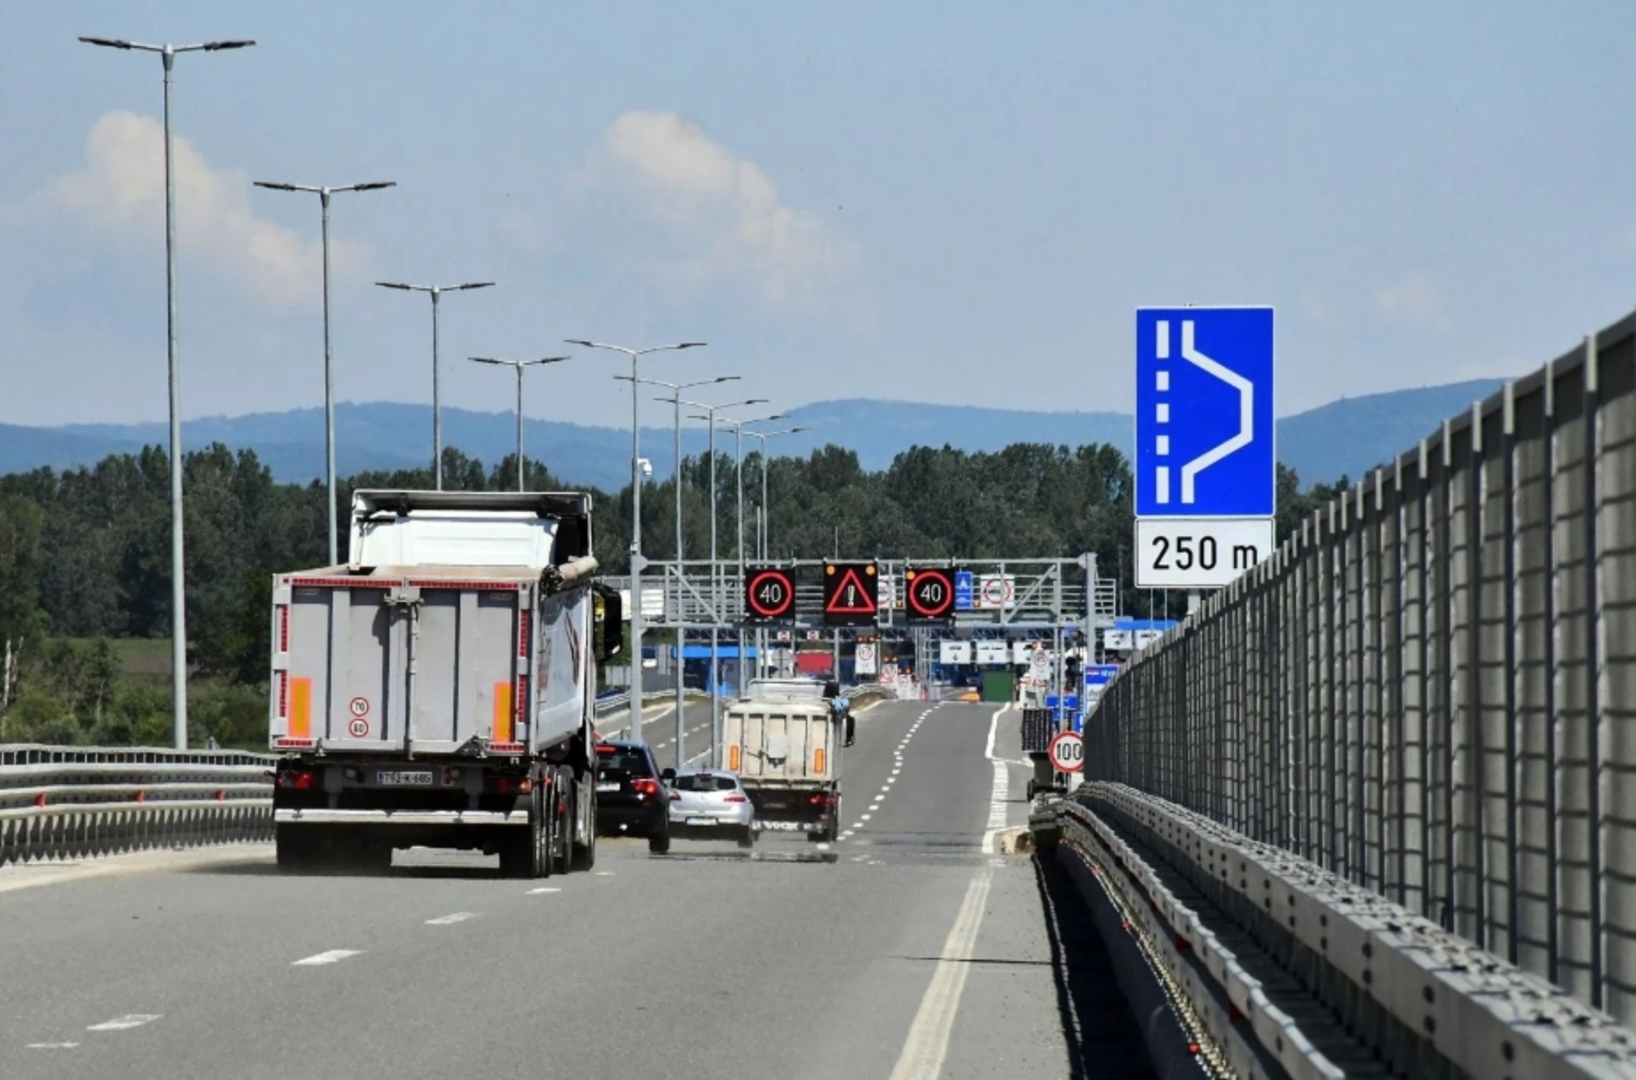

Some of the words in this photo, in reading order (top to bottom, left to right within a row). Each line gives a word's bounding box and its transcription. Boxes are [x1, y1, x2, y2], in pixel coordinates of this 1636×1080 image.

[1152, 536, 1217, 570] 250
[1233, 545, 1258, 570] m
[759, 584, 781, 603] 40
[920, 584, 941, 603] 40
[355, 702, 365, 712] 70
[1056, 743, 1083, 761] 100
